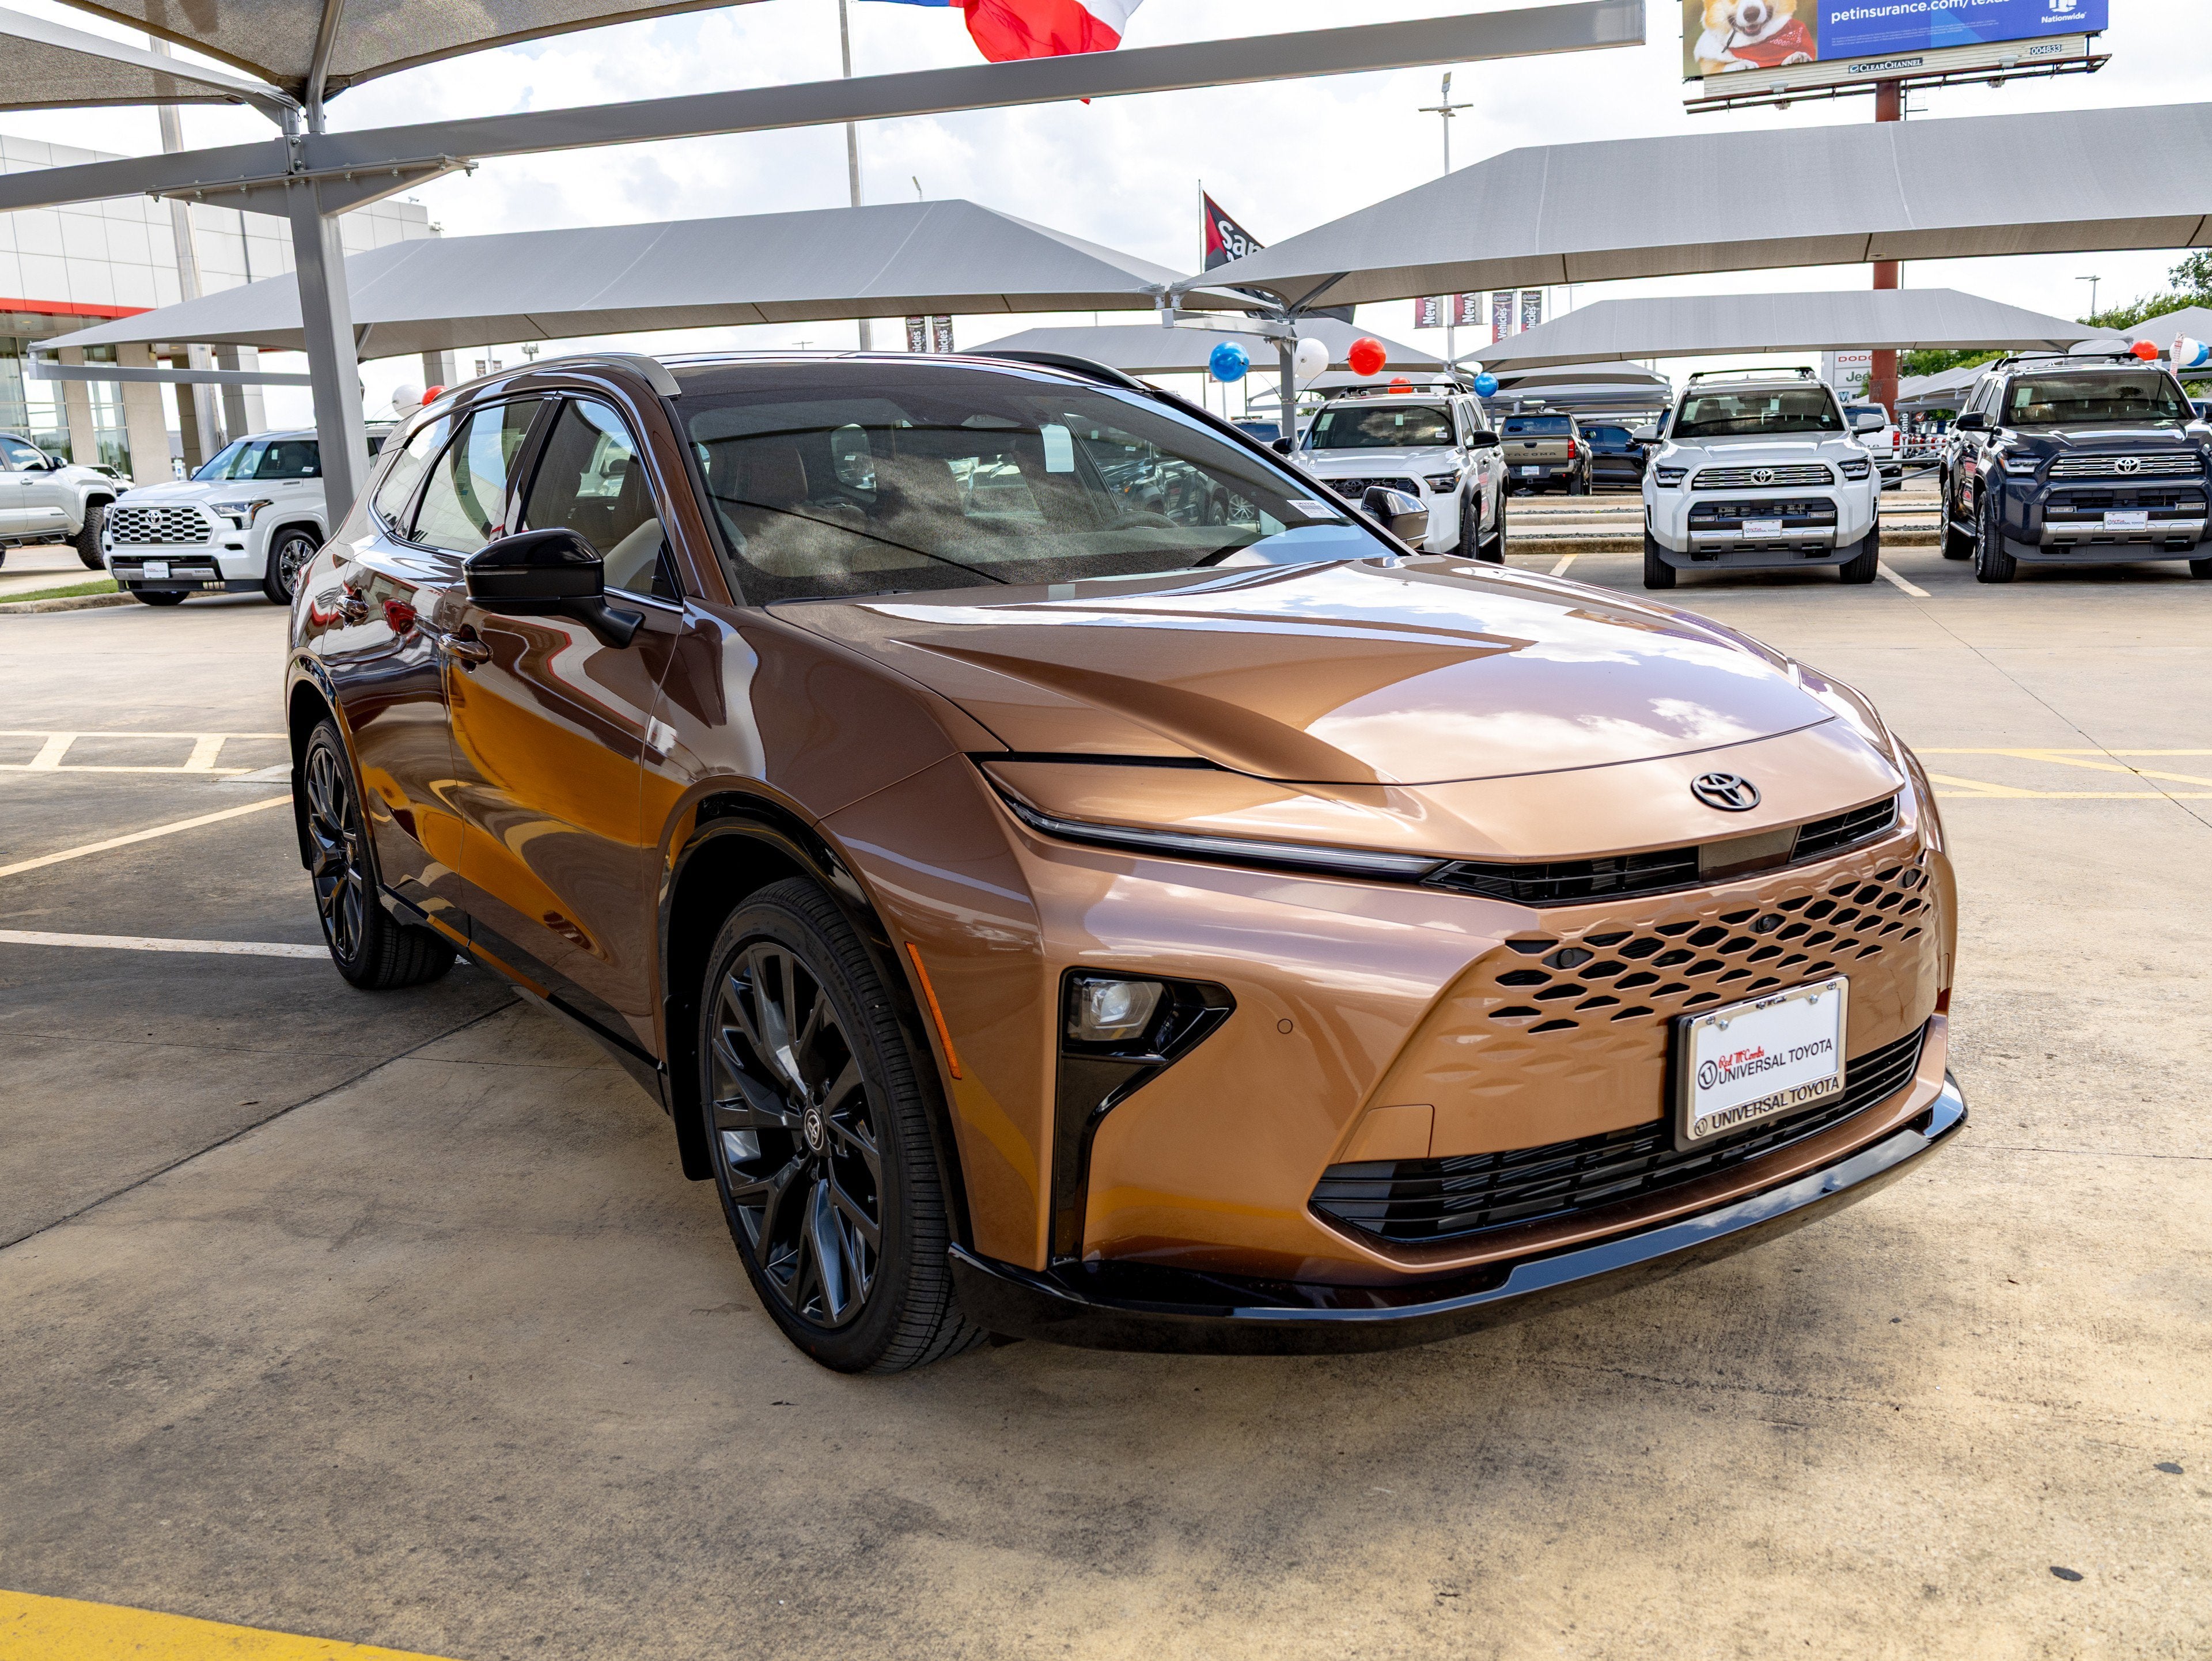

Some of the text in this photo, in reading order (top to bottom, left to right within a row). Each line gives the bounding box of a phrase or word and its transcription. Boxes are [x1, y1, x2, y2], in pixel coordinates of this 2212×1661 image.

[2041, 12, 2086, 23] Nationwide
[2031, 45, 2061, 55] 004833
[1422, 301, 1435, 324] New
[1461, 299, 1475, 323] New
[1498, 307, 1507, 339] Vehicles
[1526, 306, 1536, 328] hicles
[824, 954, 870, 1048] TURANZA
[1718, 1038, 1833, 1084] UNIVERSAL TOYOTA
[1712, 1076, 1840, 1129] UNIVERSAL TOYOTA
